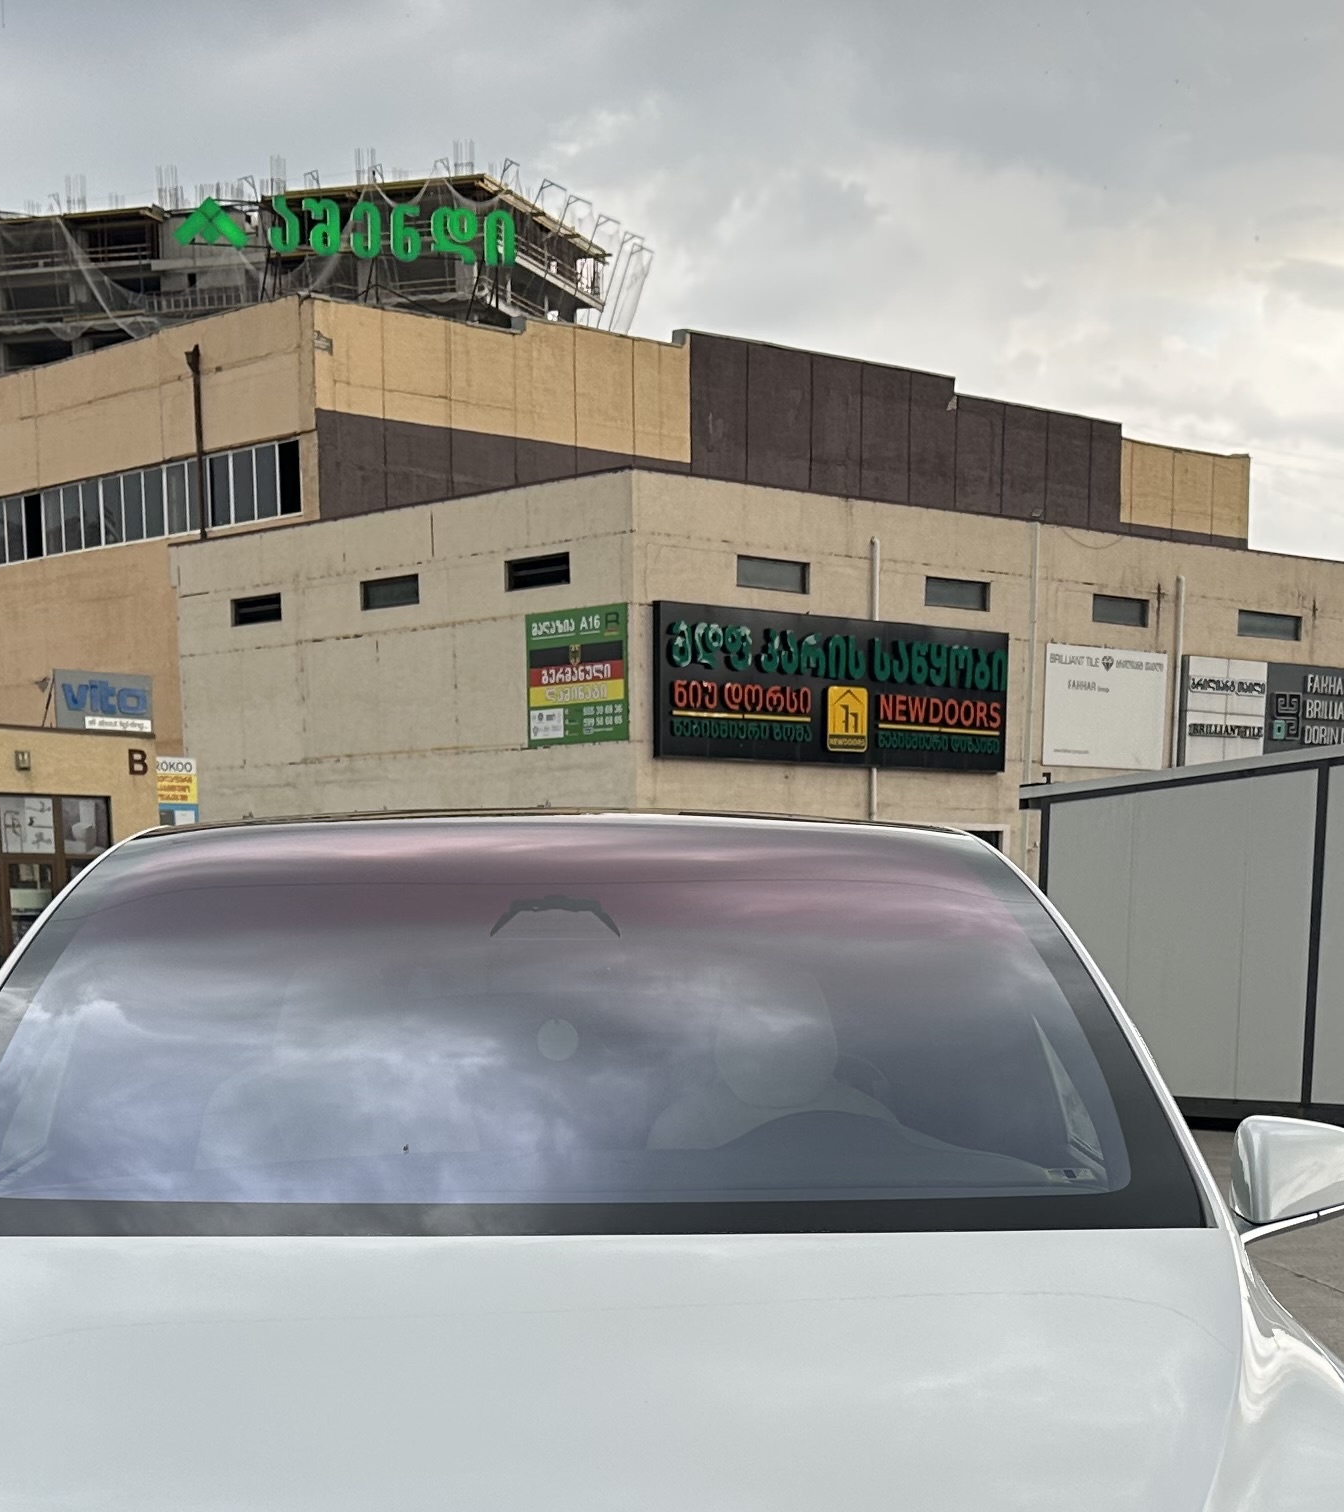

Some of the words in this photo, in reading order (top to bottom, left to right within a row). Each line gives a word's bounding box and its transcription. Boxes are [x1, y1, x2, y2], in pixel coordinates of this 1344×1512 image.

[267, 194, 518, 268] აშენდი
[580, 614, 601, 631] A16
[541, 663, 612, 685] გერმანული
[760, 627, 867, 681] კარის
[873, 637, 1007, 692] საწყობი
[61, 679, 149, 717] vito
[545, 684, 608, 703] ლამინატი
[673, 679, 719, 710] ნიუ
[723, 682, 812, 714] დორსი
[879, 693, 1002, 729] NEWDOORS
[1304, 724, 1339, 745] DORIN
[128, 748, 149, 776] B
